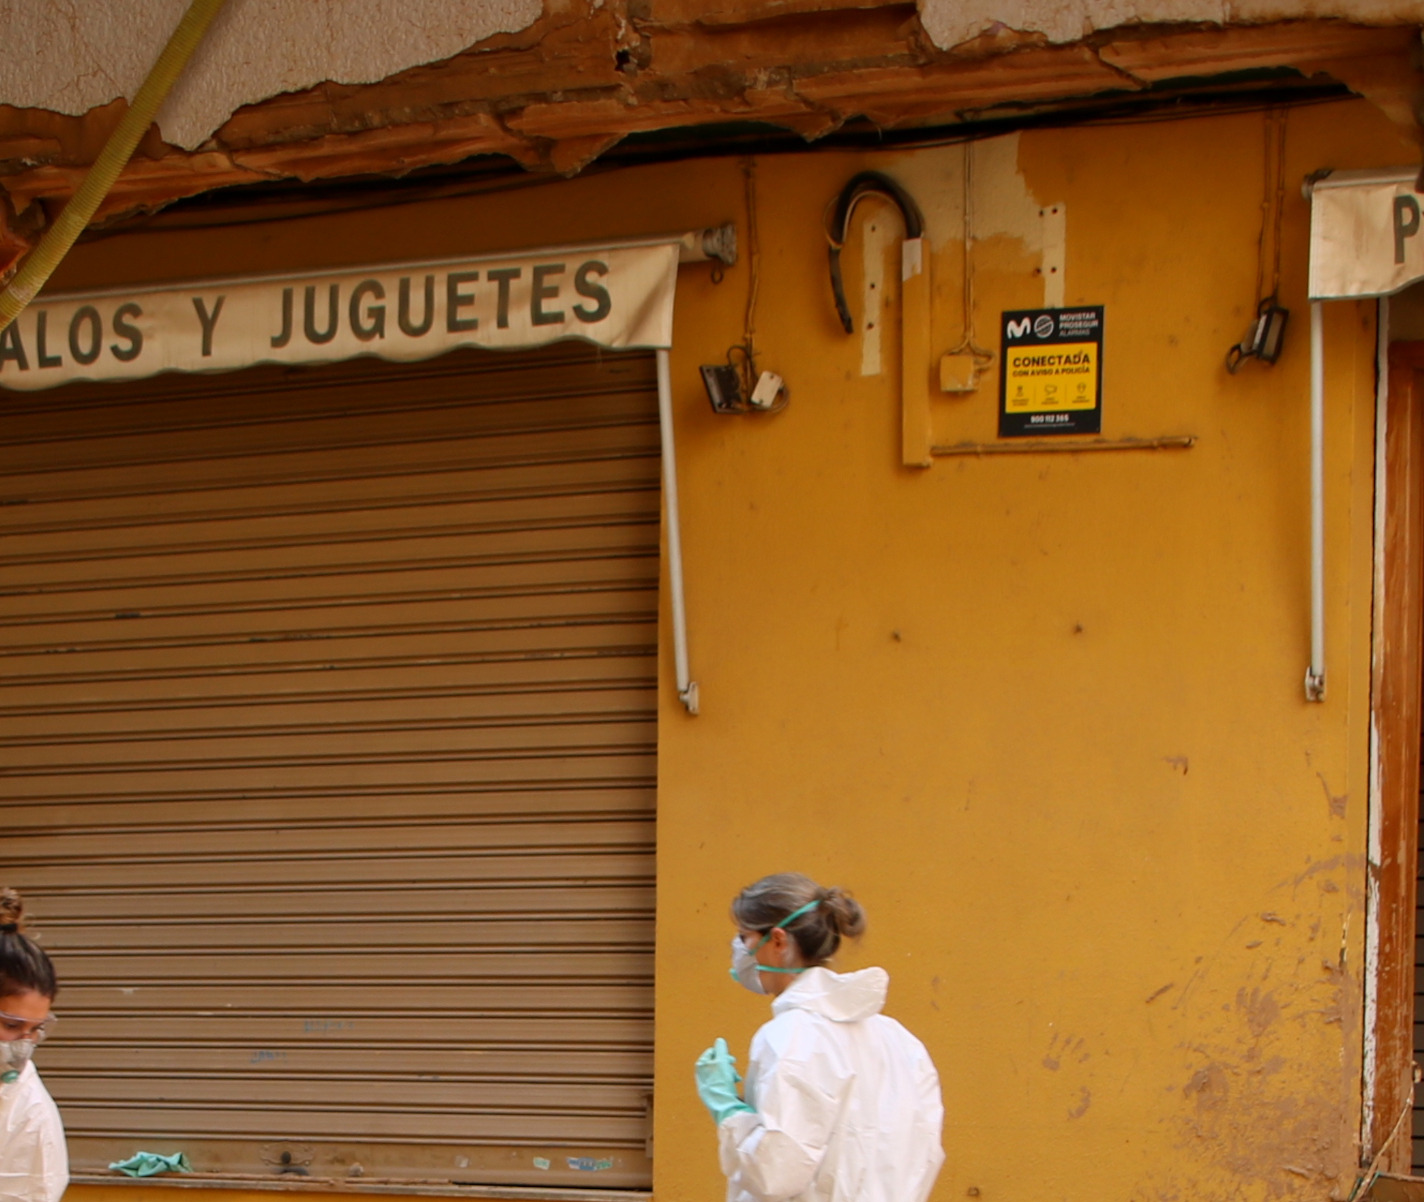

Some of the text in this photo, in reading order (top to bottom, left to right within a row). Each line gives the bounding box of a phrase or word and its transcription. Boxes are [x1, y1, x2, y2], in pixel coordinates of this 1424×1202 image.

[192, 295, 226, 357] Y
[270, 260, 612, 349] JUGUETES
[1059, 313, 1096, 321] MOVISTAR
[1059, 320, 1099, 329] PROSEGUR
[1013, 352, 1090, 368] CONECTADA
[1012, 368, 1029, 377] CON
[1030, 368, 1053, 376] AVISO
[1061, 365, 1090, 375] POLICÍA
